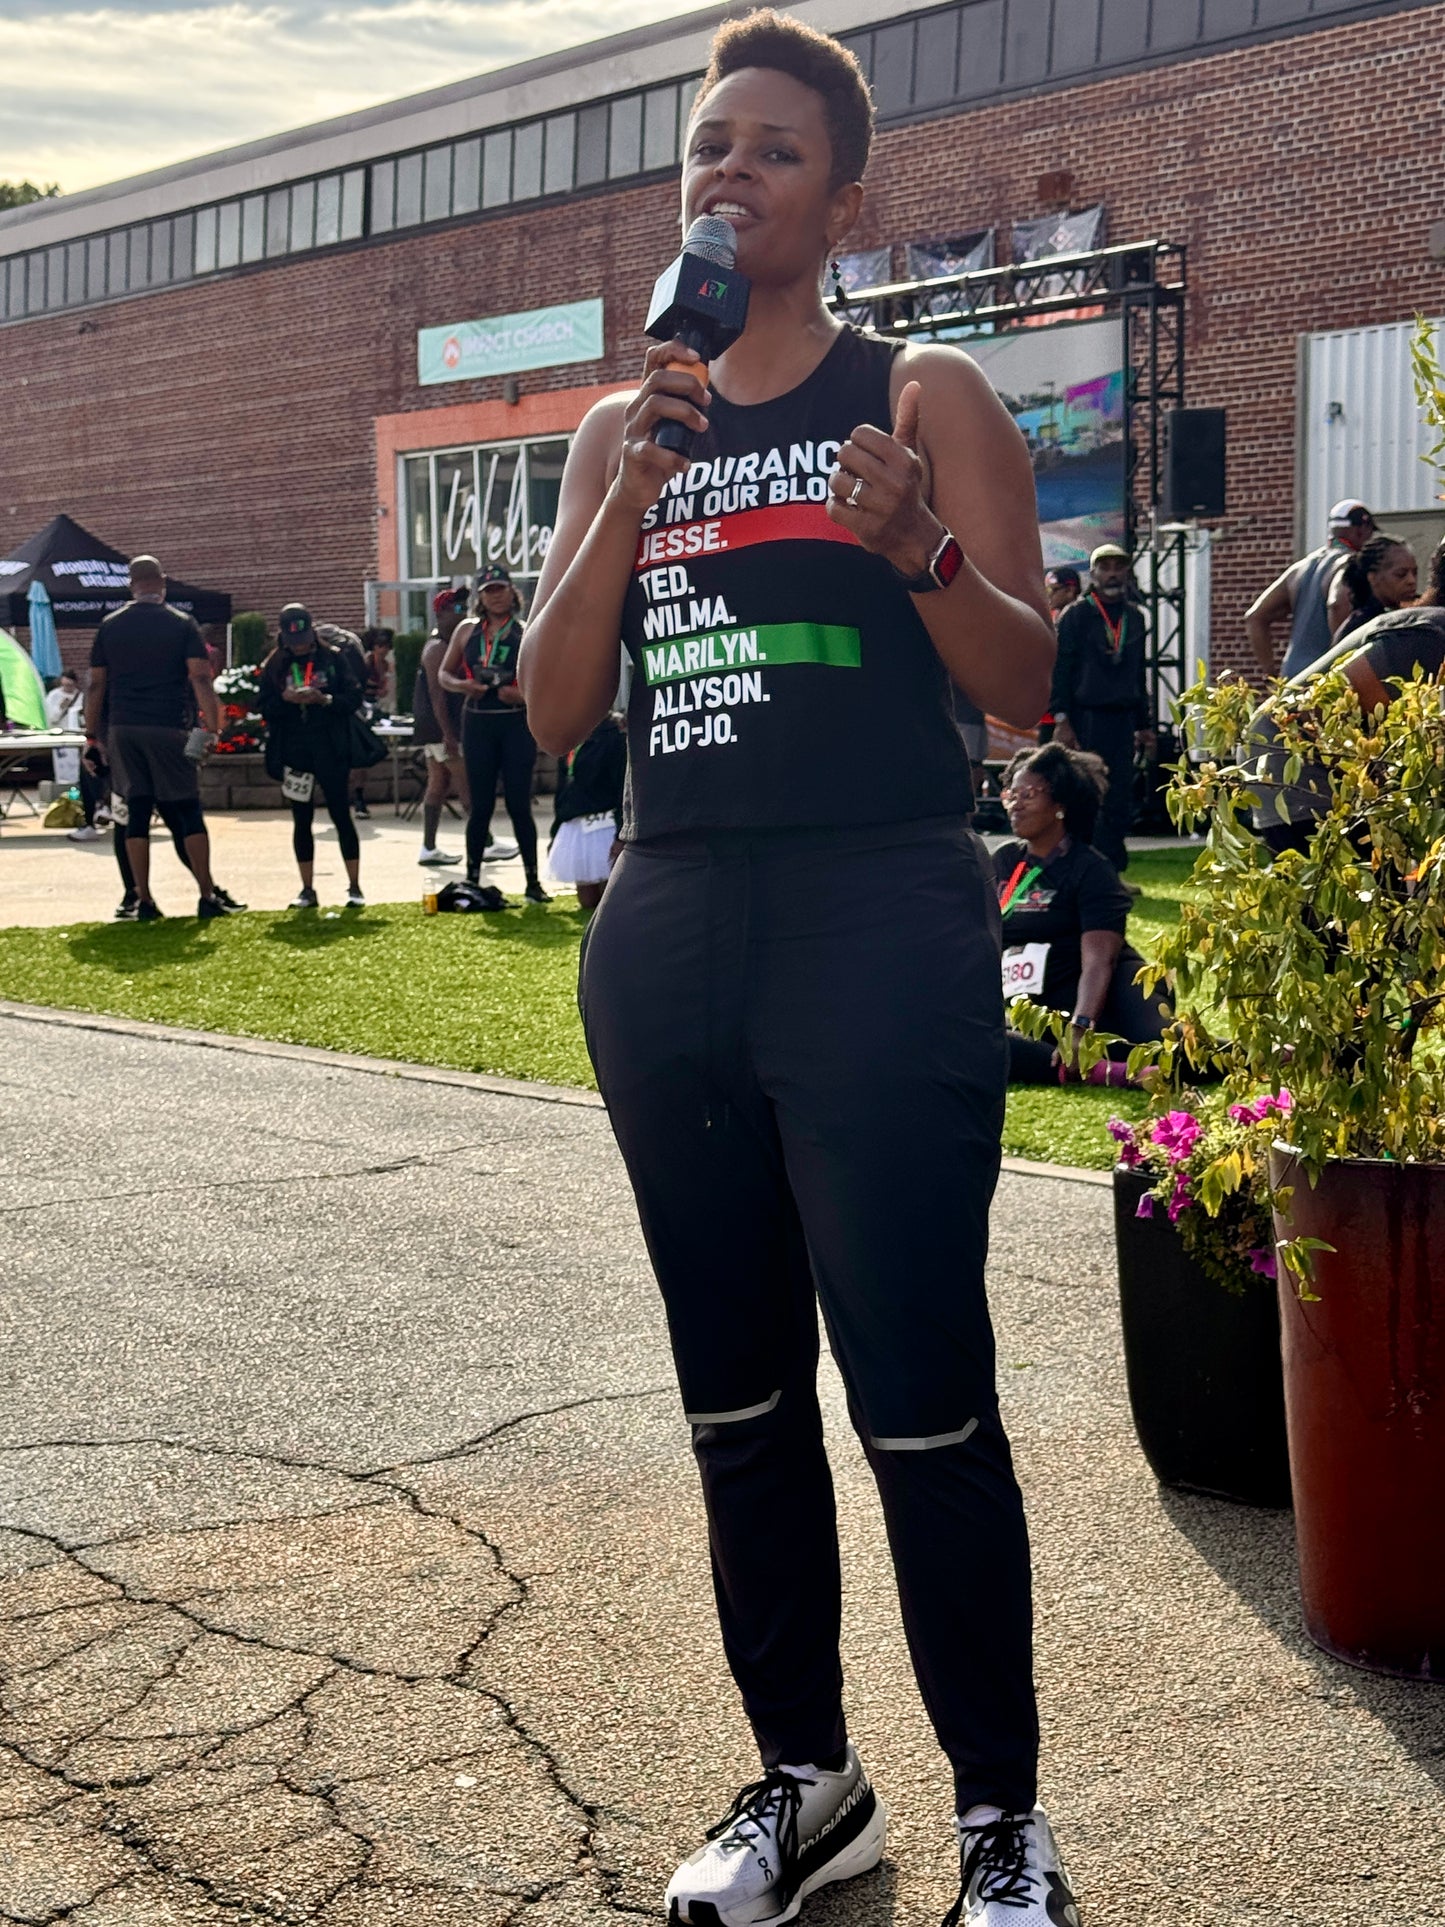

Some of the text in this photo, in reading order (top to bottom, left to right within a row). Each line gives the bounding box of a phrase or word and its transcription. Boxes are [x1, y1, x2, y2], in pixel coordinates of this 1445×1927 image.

[658, 440, 842, 499] NDURANC
[446, 453, 552, 565] Welco
[641, 476, 835, 530] S IN OUR BLO
[637, 521, 729, 566] JESSE.
[638, 565, 696, 604] TED.
[643, 595, 738, 641] WILMA.
[645, 629, 767, 681] MARILYN.
[652, 671, 771, 721] ALLYSON.
[649, 713, 738, 757] FLO-JO.
